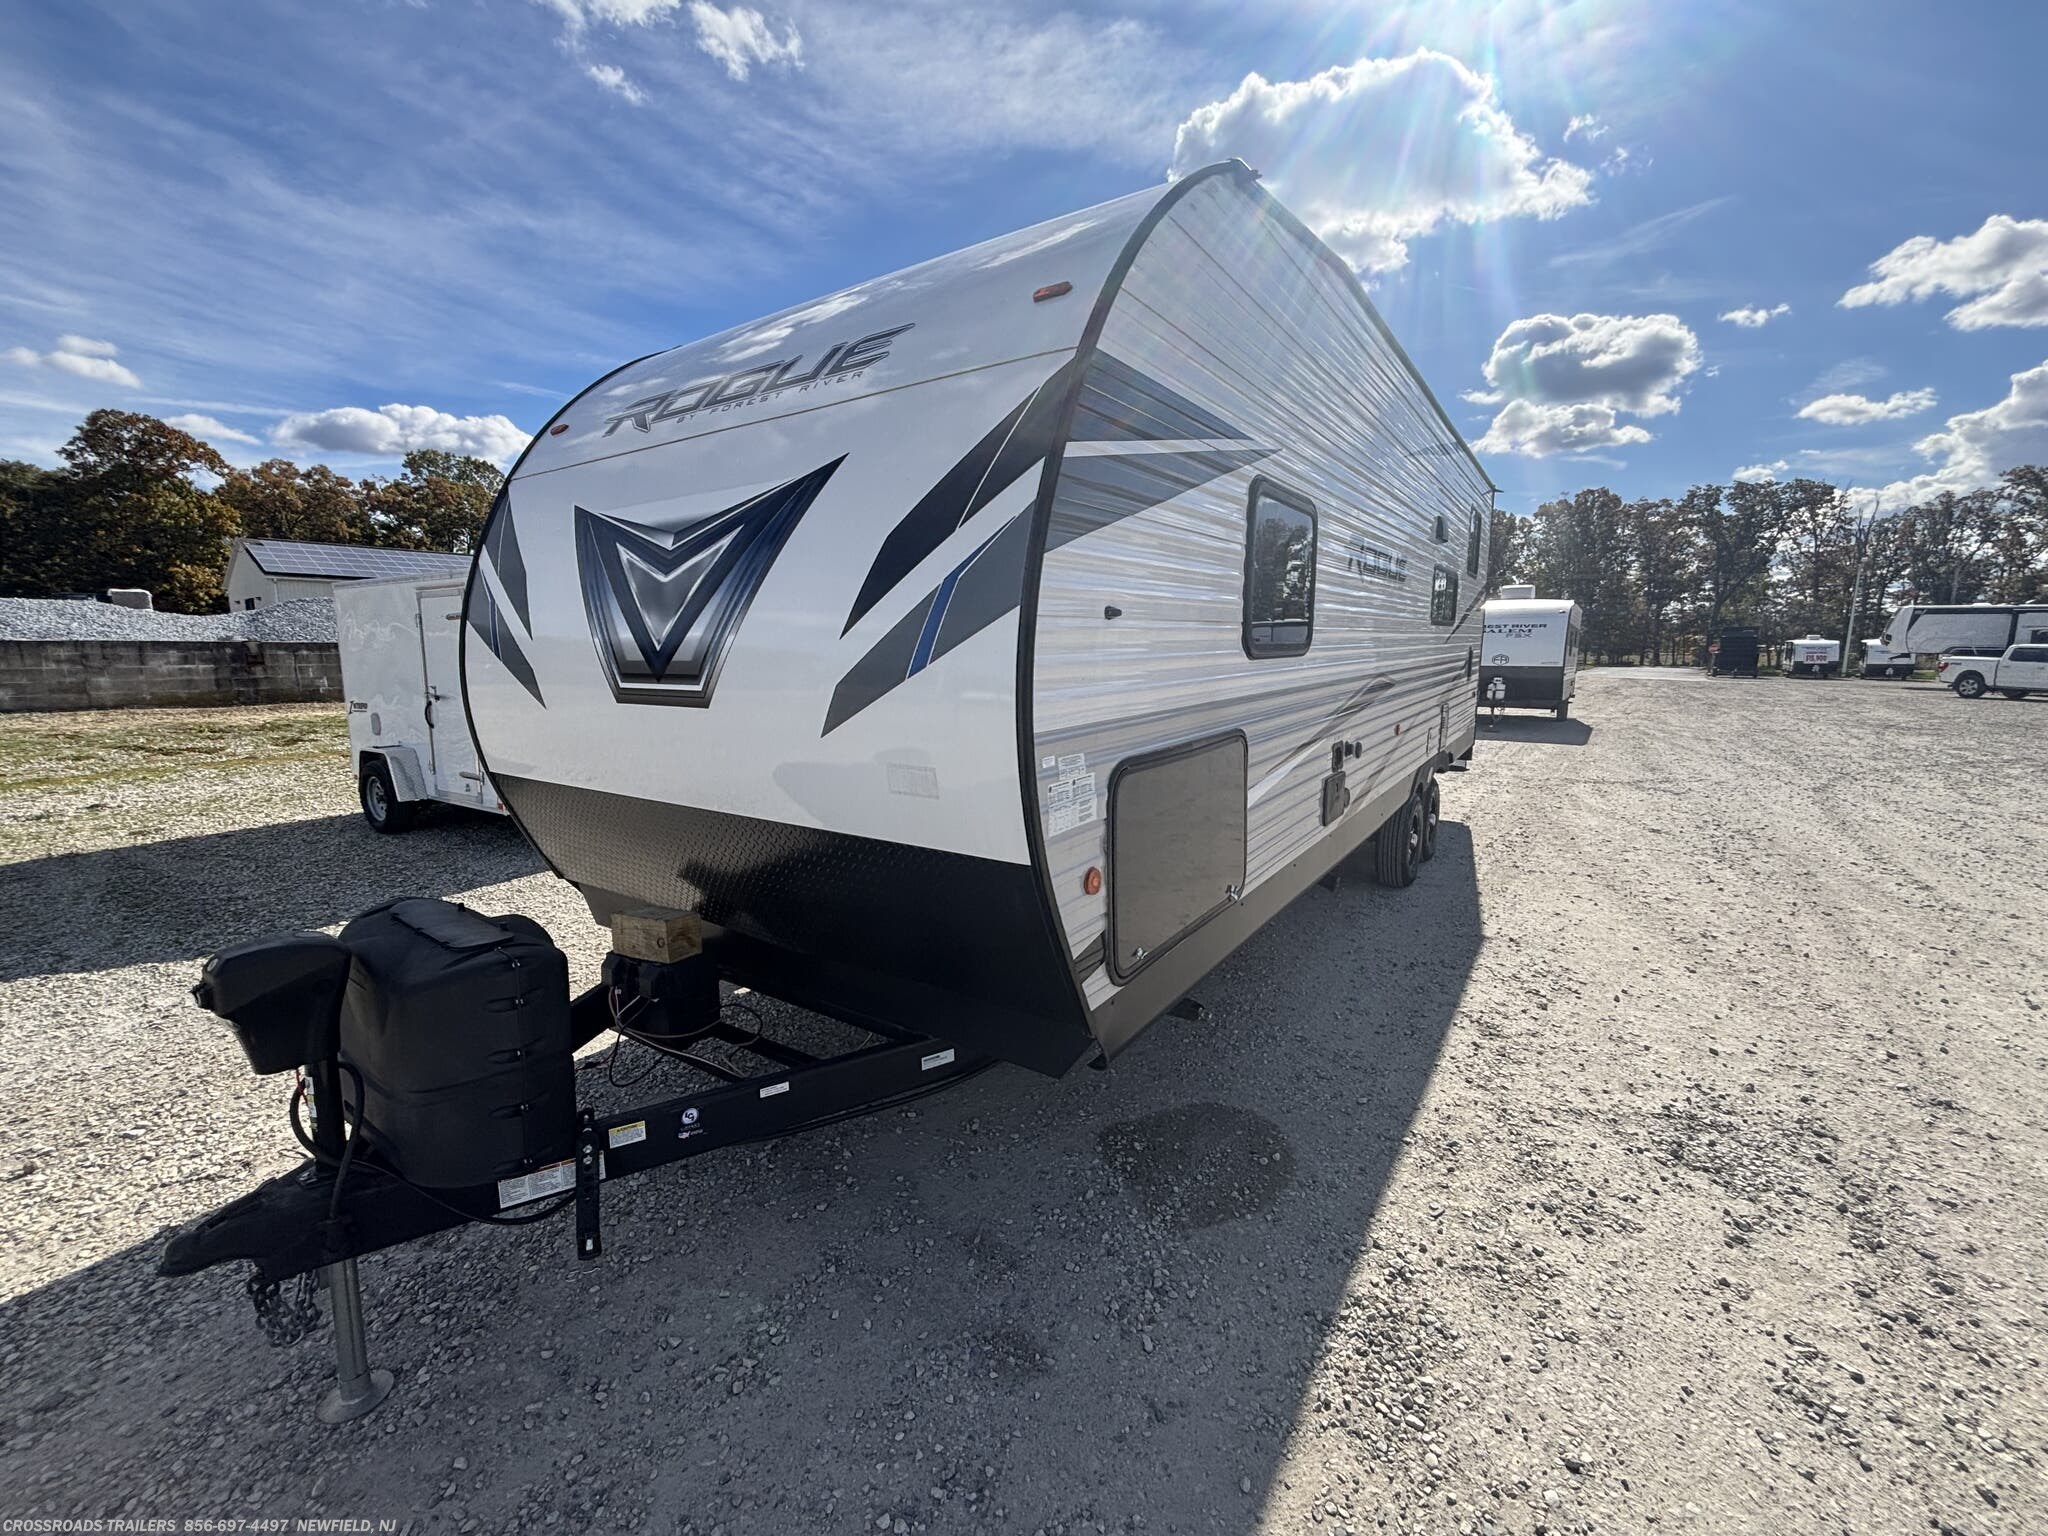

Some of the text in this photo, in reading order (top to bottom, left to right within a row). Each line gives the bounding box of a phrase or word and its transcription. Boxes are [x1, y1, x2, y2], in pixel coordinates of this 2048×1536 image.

[602, 322, 915, 437] ROGUE
[676, 371, 864, 424] BY FOREST RIVER
[1345, 540, 1407, 583] ROGUE
